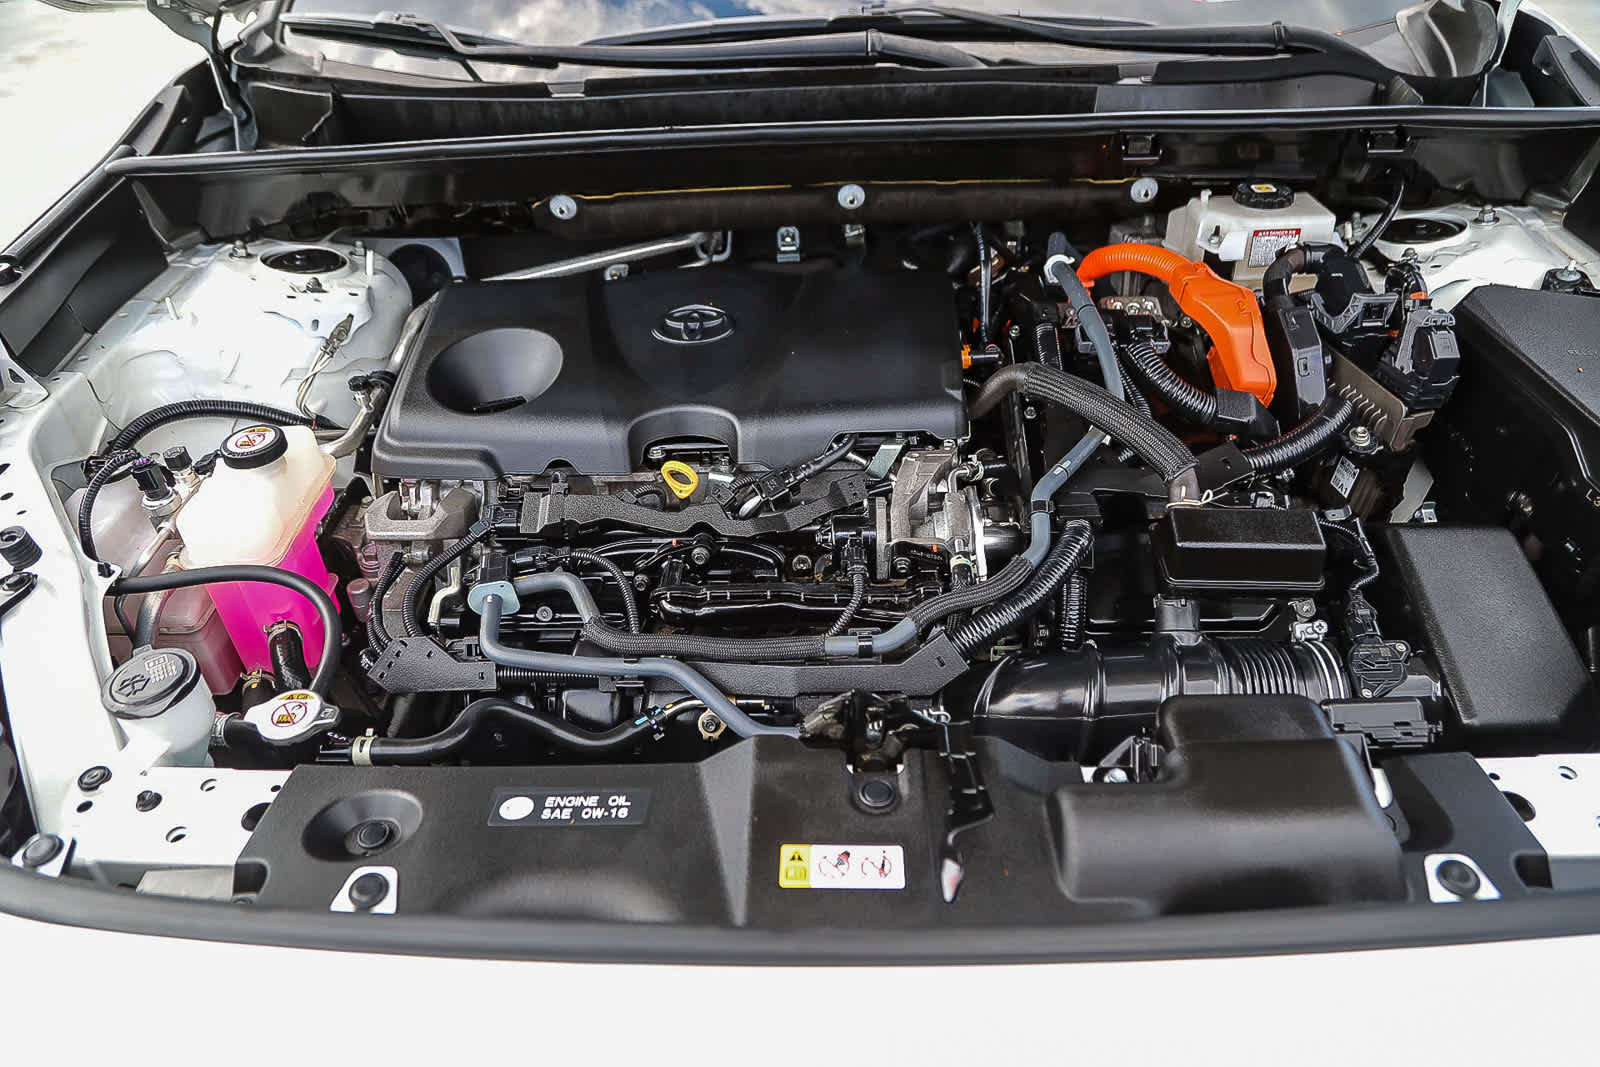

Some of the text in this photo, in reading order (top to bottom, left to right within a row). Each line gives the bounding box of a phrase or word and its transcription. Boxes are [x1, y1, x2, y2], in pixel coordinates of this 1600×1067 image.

[544, 795, 632, 807] ENGINE OIL
[541, 808, 573, 819] SAE
